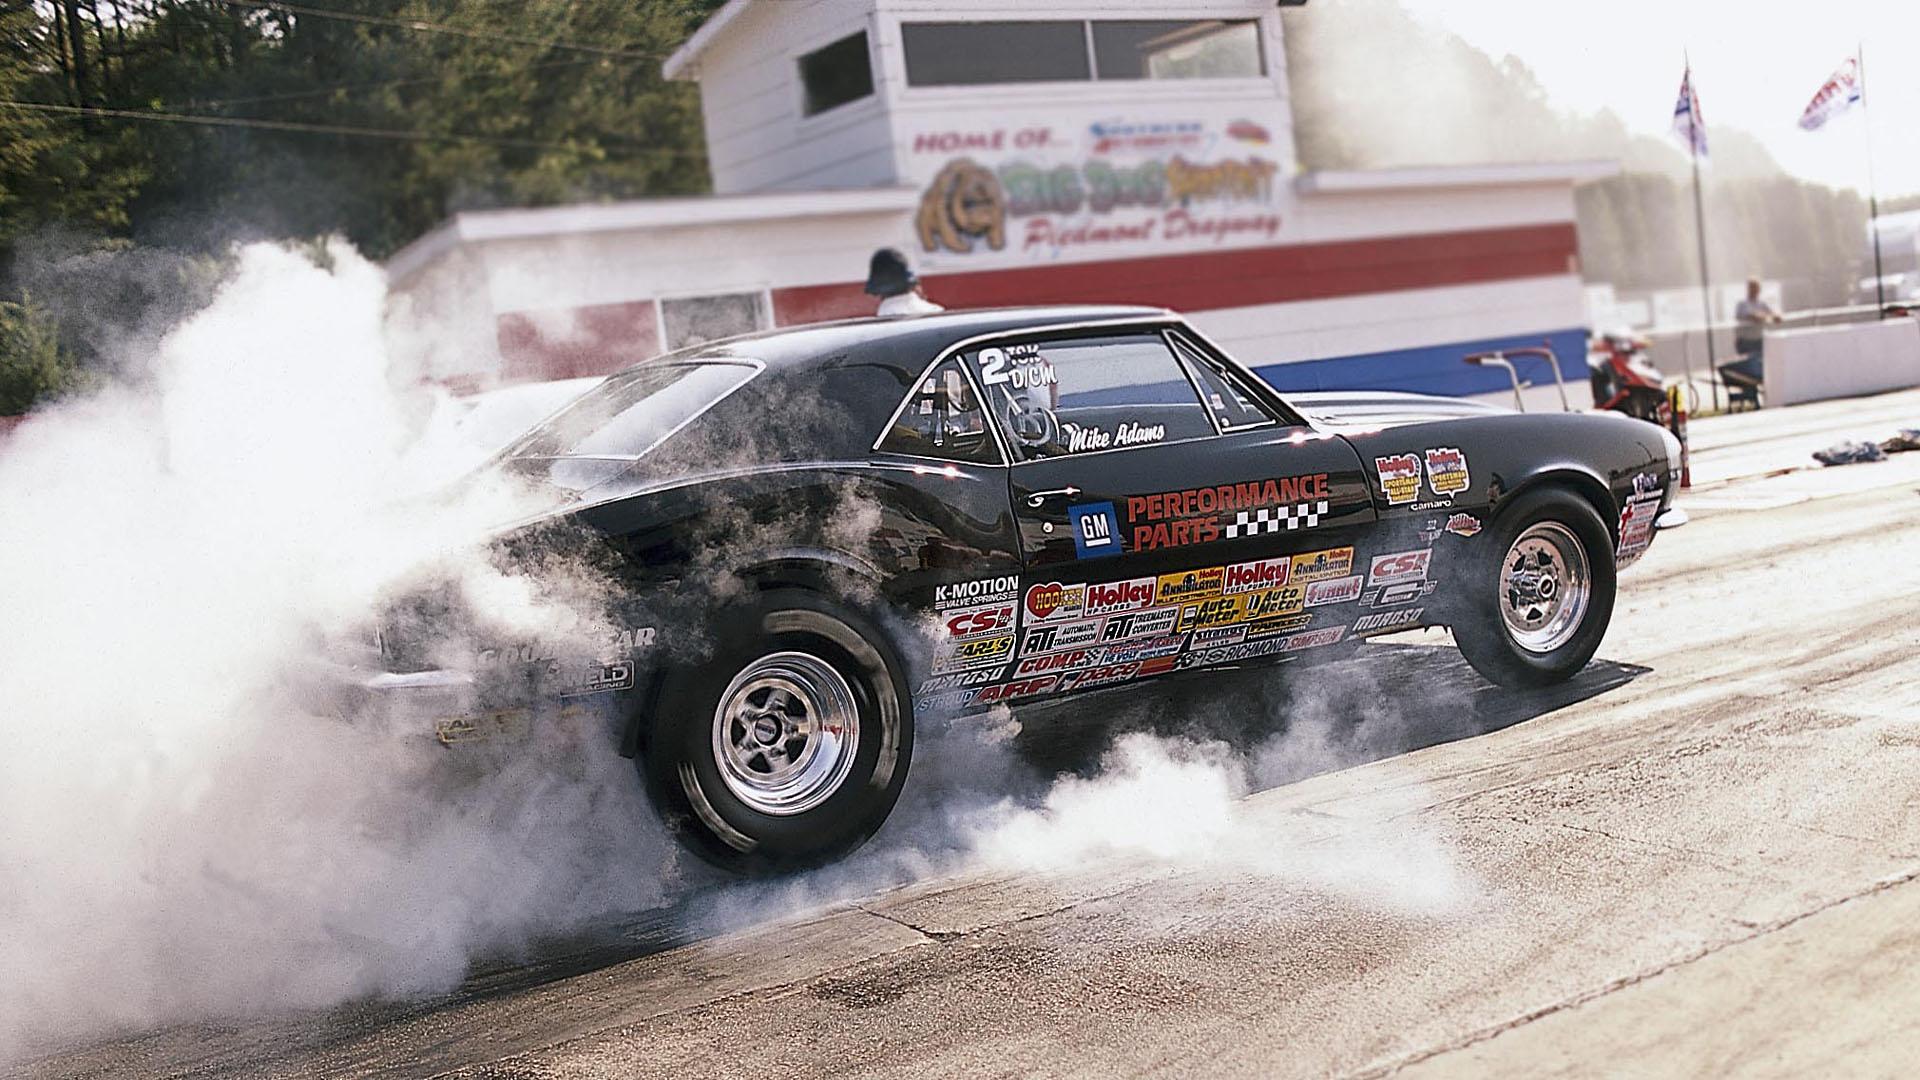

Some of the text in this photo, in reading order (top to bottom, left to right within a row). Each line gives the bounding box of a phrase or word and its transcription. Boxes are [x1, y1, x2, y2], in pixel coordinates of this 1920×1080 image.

[914, 129, 1003, 154] HOME
[1023, 208, 1281, 251] Piedmont Dragway
[978, 348, 1009, 385] 2
[1068, 422, 1165, 453] Mike Adams
[1128, 473, 1329, 523] PERFORMANCE
[1410, 500, 1451, 511] camaro
[1080, 512, 1110, 540] GM
[1133, 516, 1220, 552] PARTS
[1199, 568, 1223, 579] Holley
[1228, 562, 1288, 586] Holley
[935, 575, 1019, 602] K-MOTION
[1035, 588, 1083, 609] HOOKER
[1087, 582, 1155, 608] Holley
[1225, 581, 1274, 594] FUEL PUMPS
[1263, 587, 1299, 602] Auto
[946, 592, 1008, 609] VALVE SPRINGS
[1102, 602, 1131, 613] CARBS
[1199, 598, 1235, 613] Auto
[1259, 598, 1302, 614] Meter
[1062, 623, 1096, 635] AUTOMATIC
[1101, 613, 1136, 641] ATI
[1132, 620, 1172, 635] CONVERTER
[1196, 609, 1239, 625] Meter
[1352, 607, 1424, 631] MOROSO
[1023, 625, 1059, 654] ATI
[1223, 636, 1289, 661] RICHMOND
[1287, 630, 1340, 650] SIMPSON
[1019, 650, 1086, 673] COMP
[975, 676, 1057, 703] ARP
